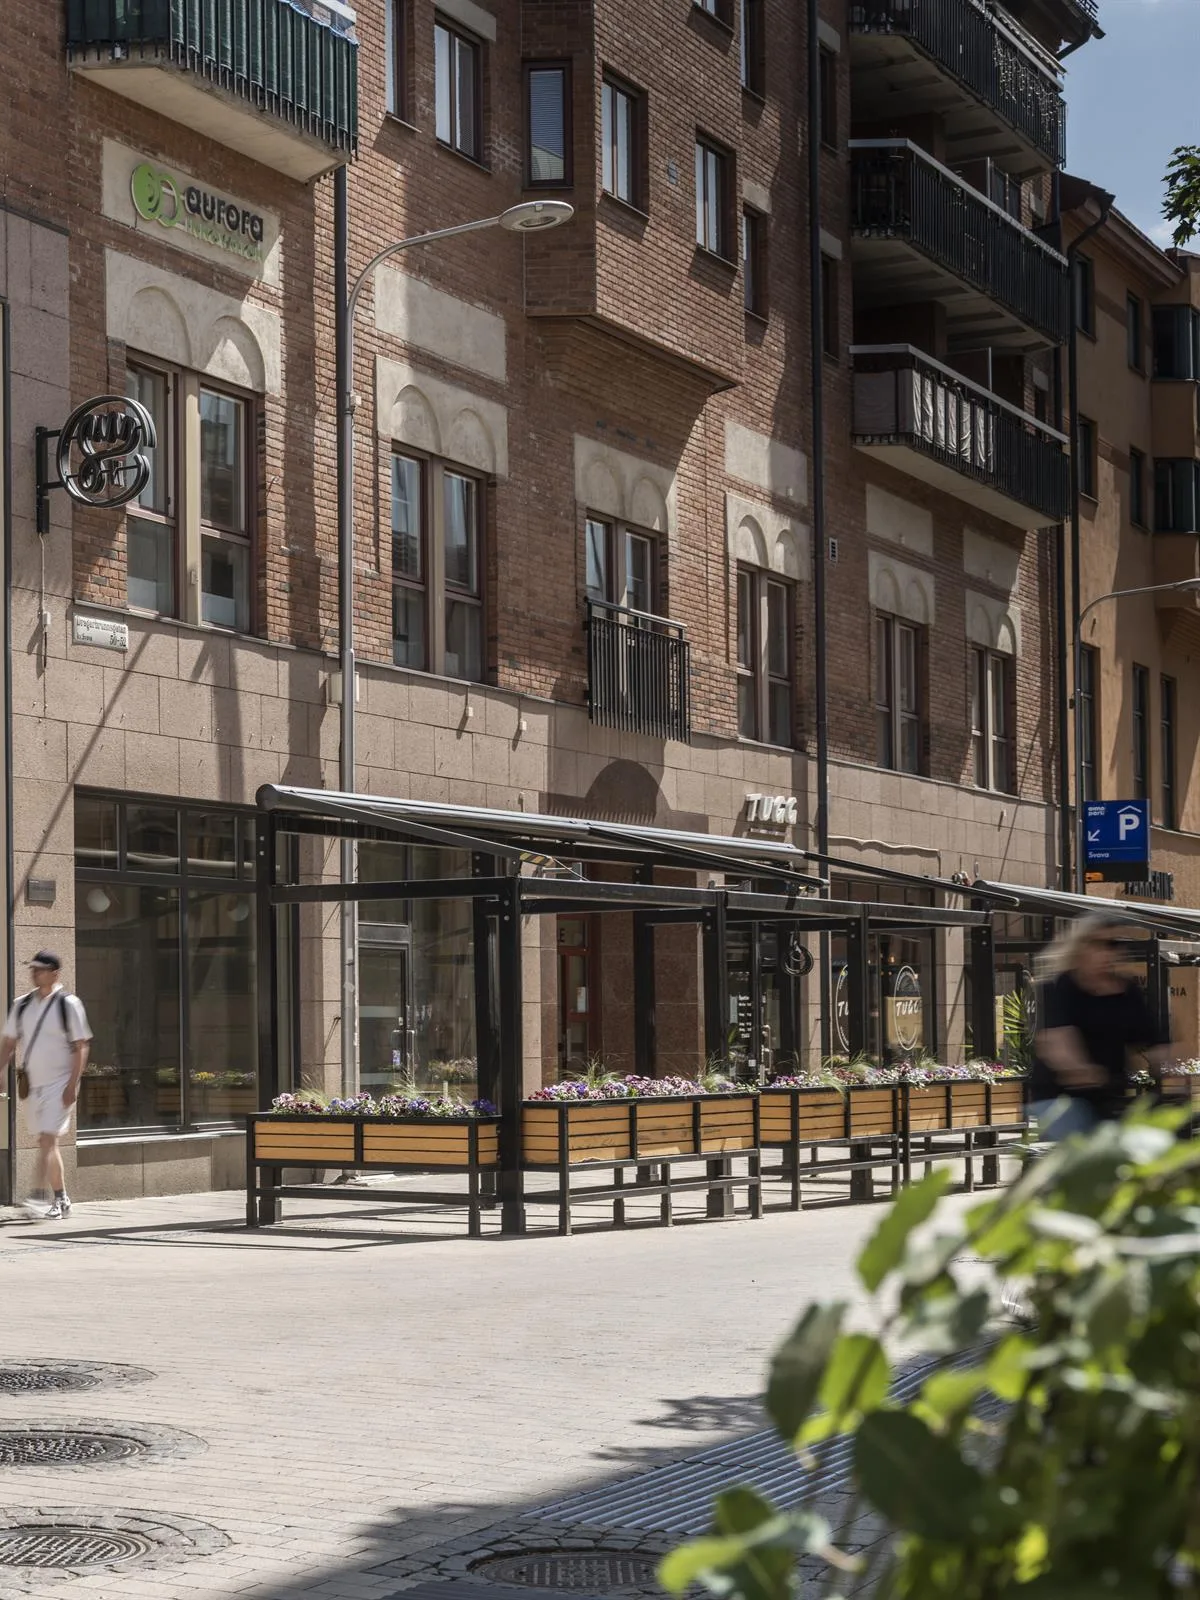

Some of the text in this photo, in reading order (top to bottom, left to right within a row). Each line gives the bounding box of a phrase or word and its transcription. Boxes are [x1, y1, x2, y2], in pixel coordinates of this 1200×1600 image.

[184, 186, 264, 242] aurora
[746, 793, 798, 825] TUGG
[1119, 813, 1140, 841] P
